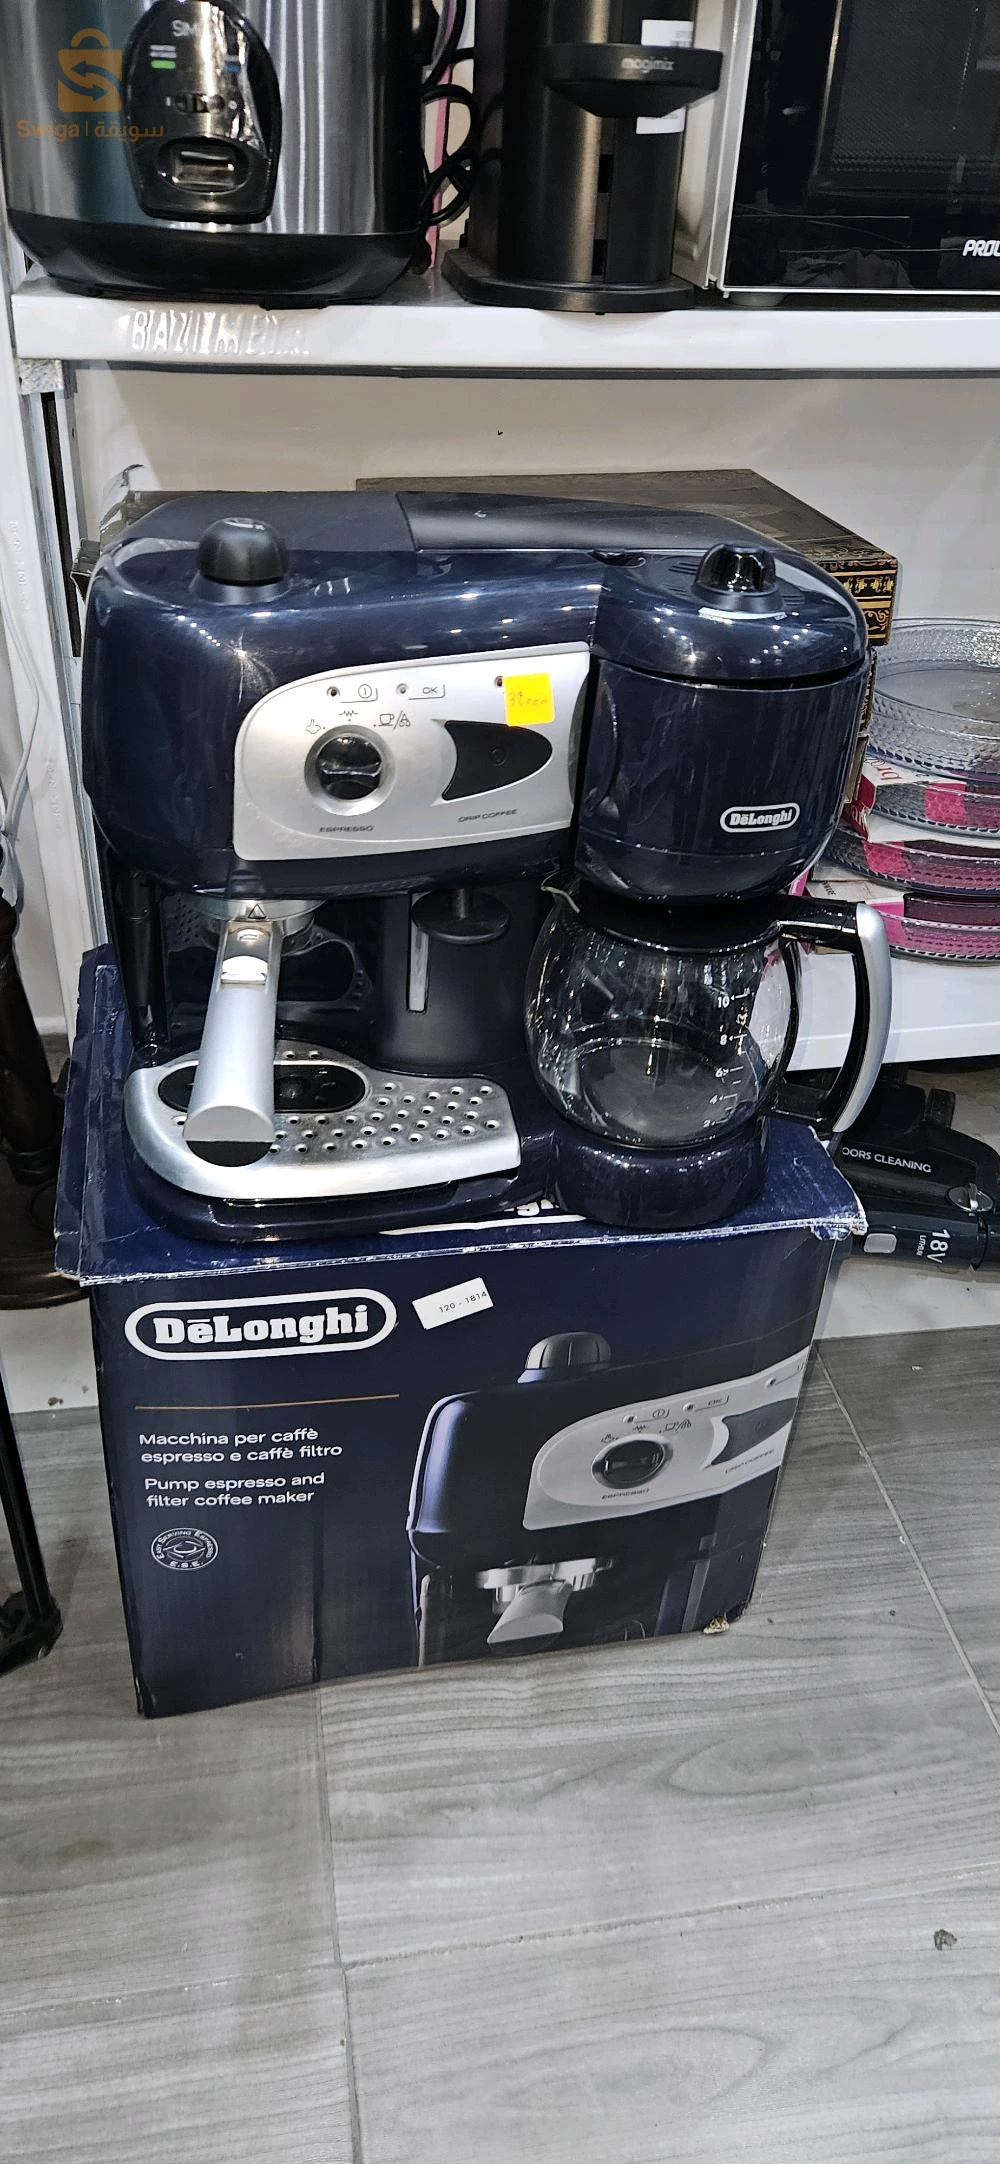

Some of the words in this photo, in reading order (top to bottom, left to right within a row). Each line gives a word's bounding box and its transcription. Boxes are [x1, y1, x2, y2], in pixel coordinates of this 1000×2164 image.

[422, 686, 439, 695] OK
[458, 814, 481, 823] DRIP
[482, 808, 518, 820] COFFEE
[319, 825, 374, 833] ESPRESSO
[717, 996, 730, 1009] 10
[719, 1034, 728, 1046] 8
[715, 1066, 723, 1078] 6
[873, 1153, 932, 1173] CLEANING
[926, 1228, 951, 1264] 18V
[439, 1301, 456, 1314] 120
[464, 1290, 488, 1305] 1814
[139, 1432, 229, 1446] Macchina
[234, 1433, 266, 1447] per
[271, 1427, 318, 1443] caffè
[141, 1451, 225, 1465] espresso
[229, 1452, 242, 1462] e
[247, 1447, 293, 1461] caffè
[299, 1445, 343, 1458] filtro
[144, 1478, 199, 1492] Pump
[204, 1477, 287, 1491] espresso
[291, 1472, 325, 1486] and
[146, 1494, 189, 1507] filter
[194, 1494, 253, 1506] coffee
[258, 1491, 314, 1504] maker
